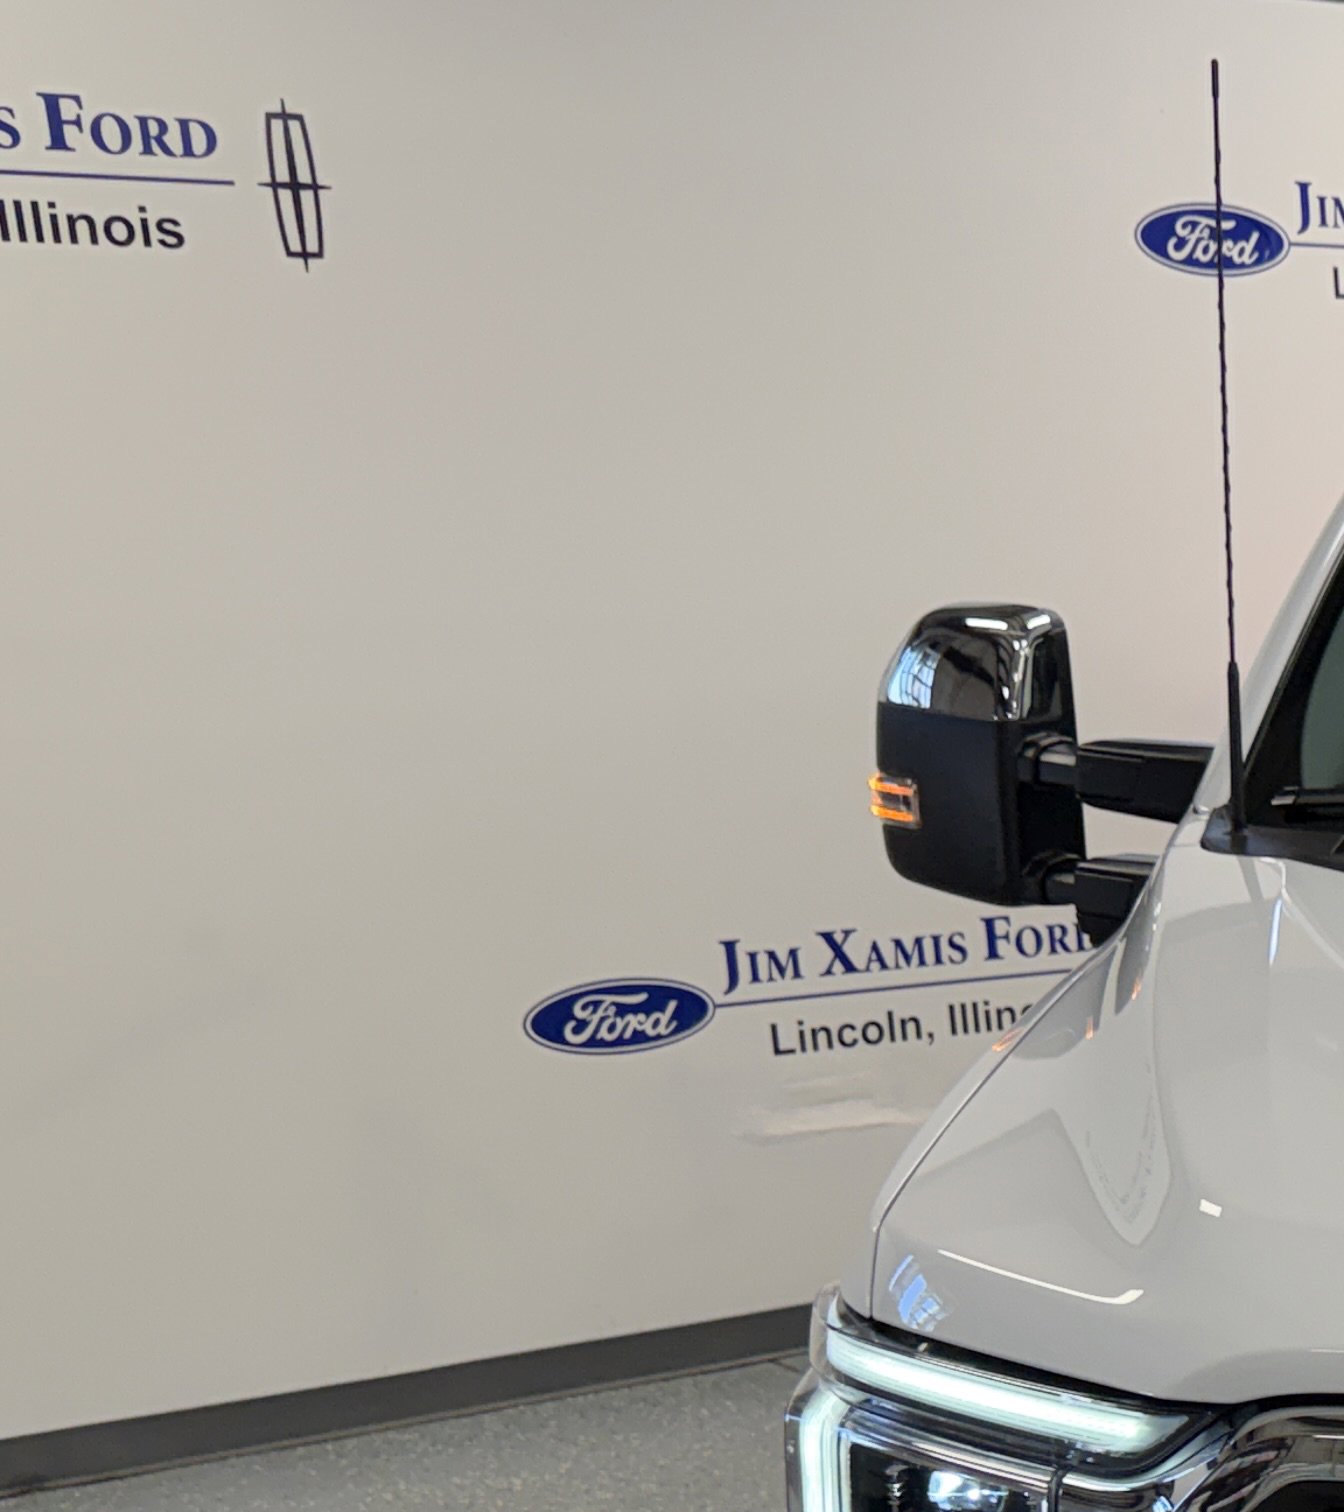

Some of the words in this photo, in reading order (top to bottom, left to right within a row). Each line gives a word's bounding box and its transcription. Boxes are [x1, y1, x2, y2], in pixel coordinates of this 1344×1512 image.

[36, 91, 218, 159] FORD
[0, 199, 186, 249] Illinois
[1166, 214, 1259, 266] Ford
[719, 939, 804, 996] JIM
[814, 927, 969, 978] XAMIS
[562, 991, 679, 1045] Ford
[770, 1010, 935, 1057] Lincoln,
[948, 1000, 1032, 1039] Illin
